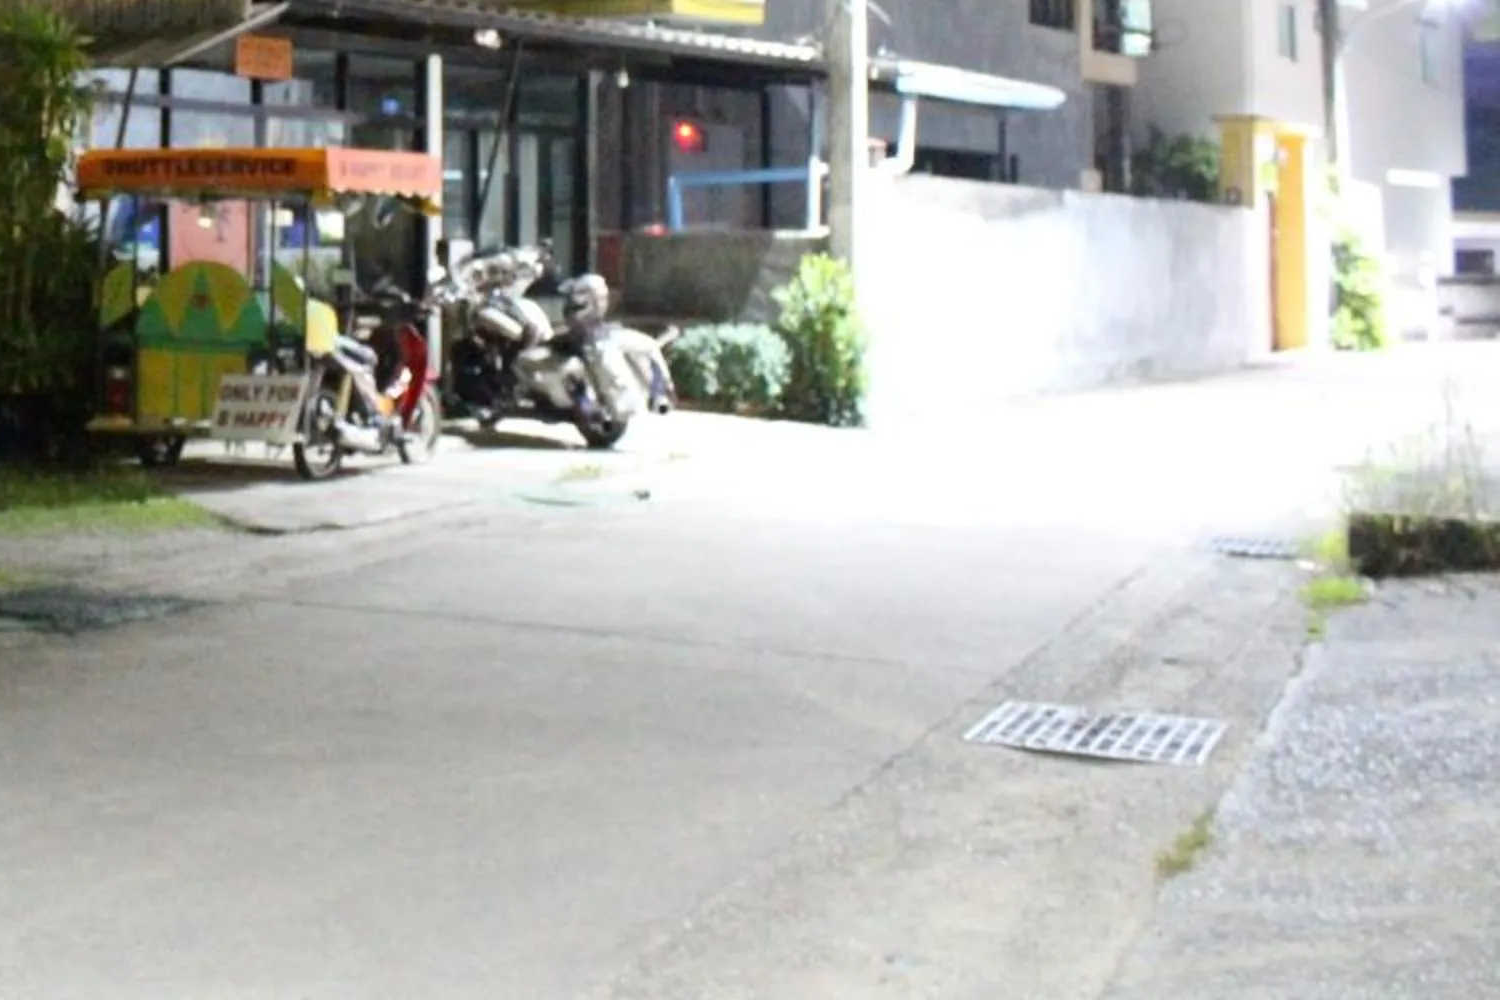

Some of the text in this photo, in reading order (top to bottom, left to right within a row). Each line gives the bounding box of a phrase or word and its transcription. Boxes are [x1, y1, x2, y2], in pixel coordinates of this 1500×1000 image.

[220, 384, 300, 403] ONLY FOR
[233, 411, 287, 429] HAPPY
